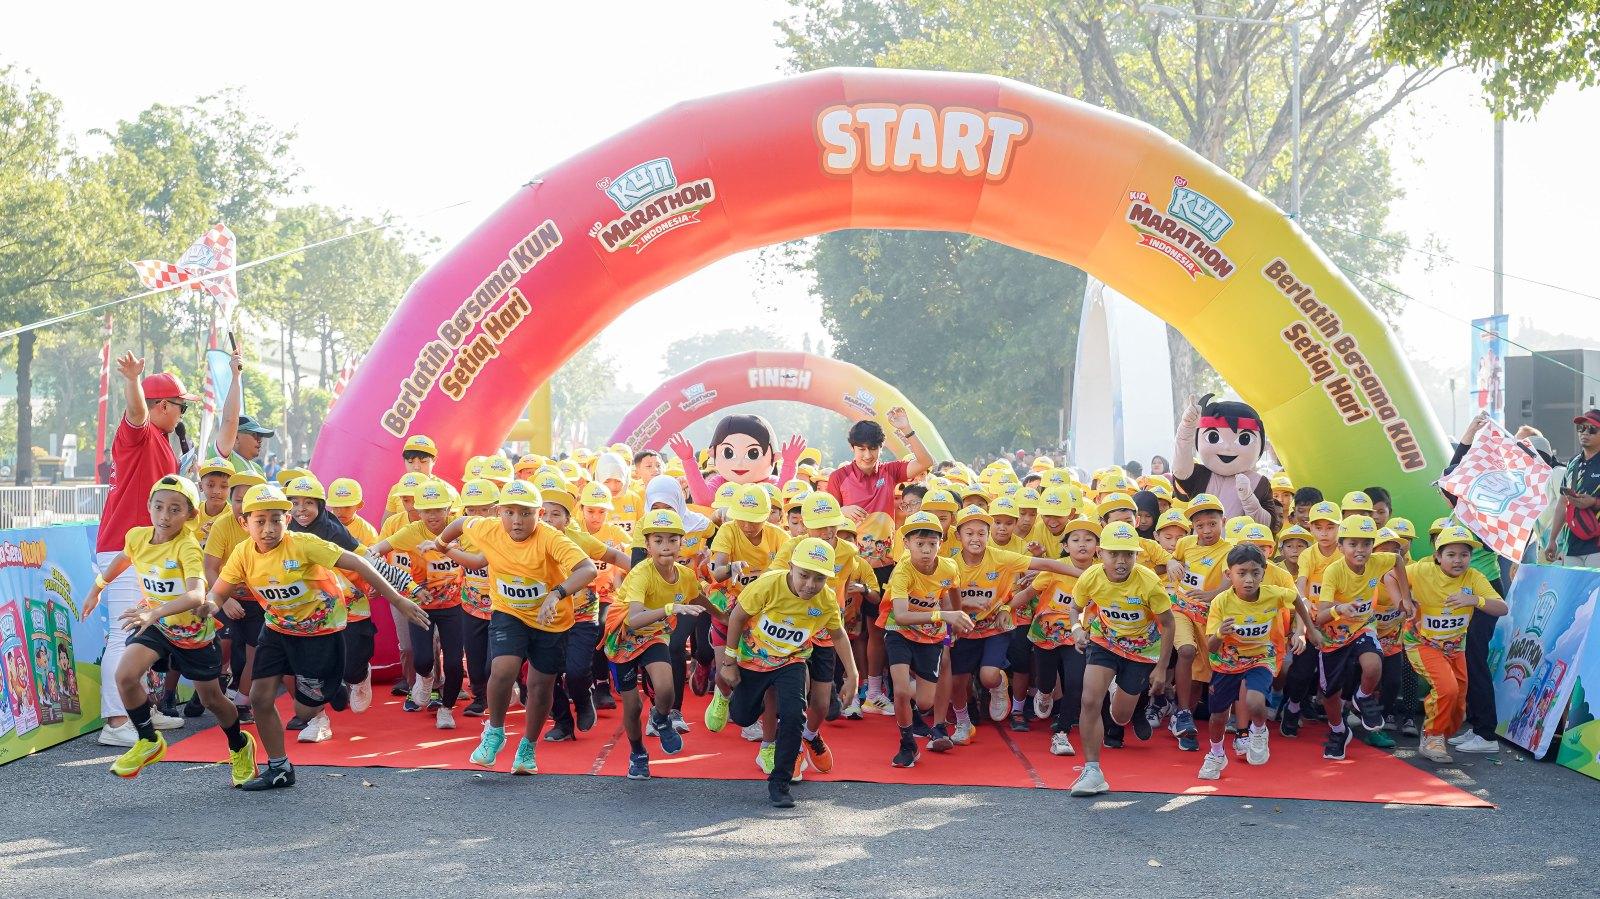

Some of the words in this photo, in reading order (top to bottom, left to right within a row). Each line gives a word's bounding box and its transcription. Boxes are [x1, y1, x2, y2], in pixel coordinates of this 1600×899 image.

[822, 108, 1024, 175] START
[588, 221, 603, 238] KID
[602, 182, 711, 248] MARATHON
[641, 214, 689, 244] INDONESIA
[1129, 204, 1234, 278] MARATHON
[1148, 238, 1196, 272] INDONESIA
[384, 342, 450, 435] Berlatih
[440, 263, 517, 346] Bersama
[512, 223, 559, 270] KUN
[484, 291, 528, 341] Hari
[749, 368, 812, 389] FINISH
[1265, 260, 1340, 338] Berlatih
[1333, 336, 1397, 421] Bersama
[1387, 422, 1424, 470] KUN
[1326, 377, 1370, 423] Hari
[143, 577, 175, 593] 0137
[259, 585, 300, 600] 10130
[503, 584, 539, 598] 10011
[1058, 593, 1074, 605] 10
[763, 619, 804, 643] 10070
[1427, 617, 1465, 629] 10232
